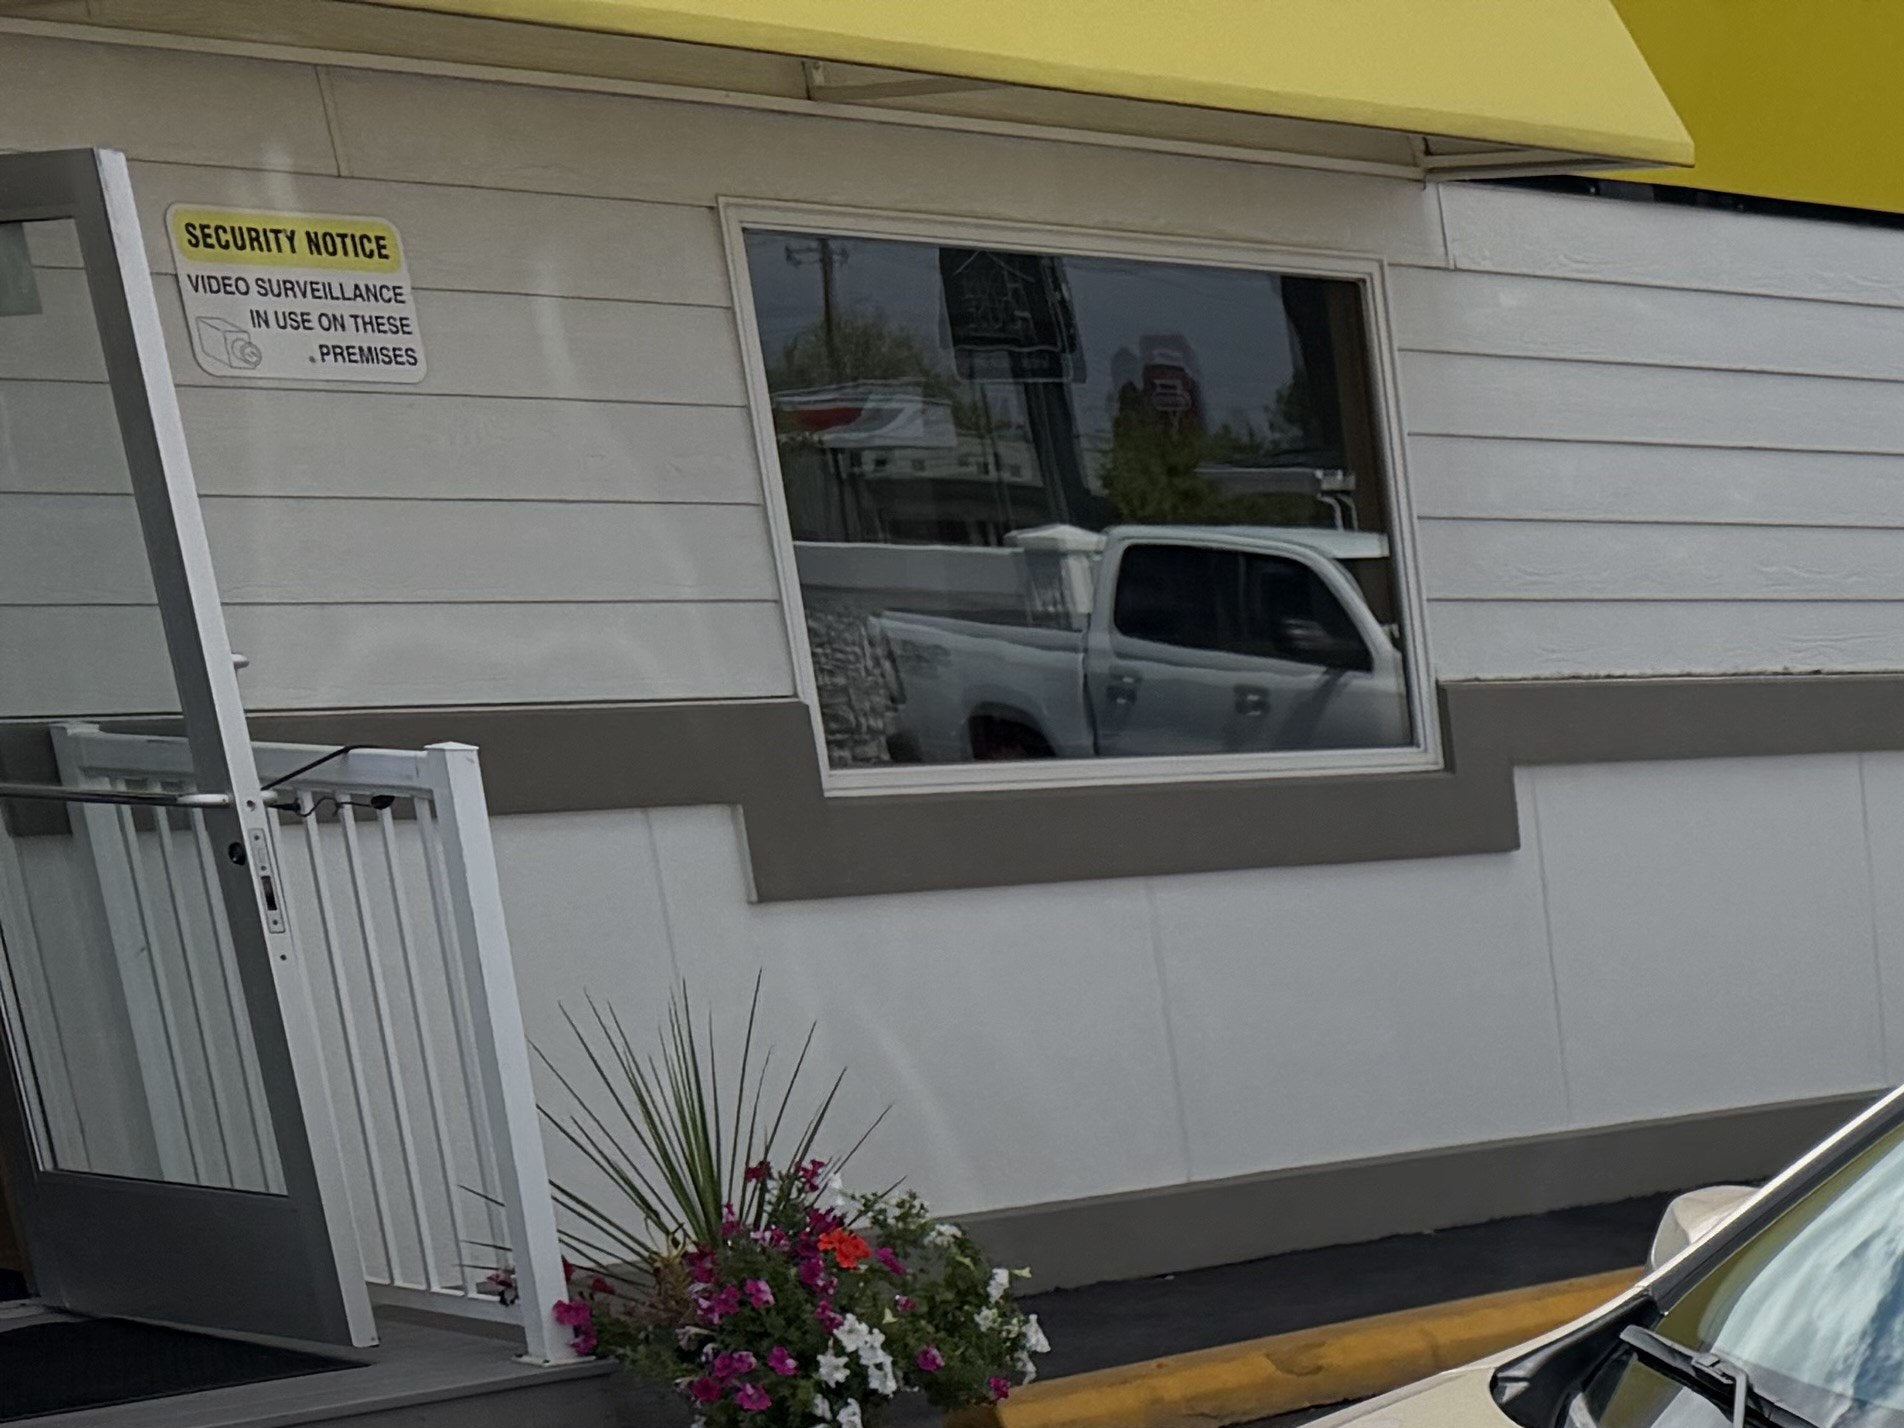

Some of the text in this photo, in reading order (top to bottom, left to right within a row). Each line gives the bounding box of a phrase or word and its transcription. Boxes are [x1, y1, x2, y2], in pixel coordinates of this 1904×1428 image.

[184, 222, 390, 260] SECURITY NOTICE
[187, 274, 406, 304] VIDEO SURVEILLANCE
[250, 309, 413, 335] IN USE ON THESE
[318, 344, 418, 367] PREMISES
